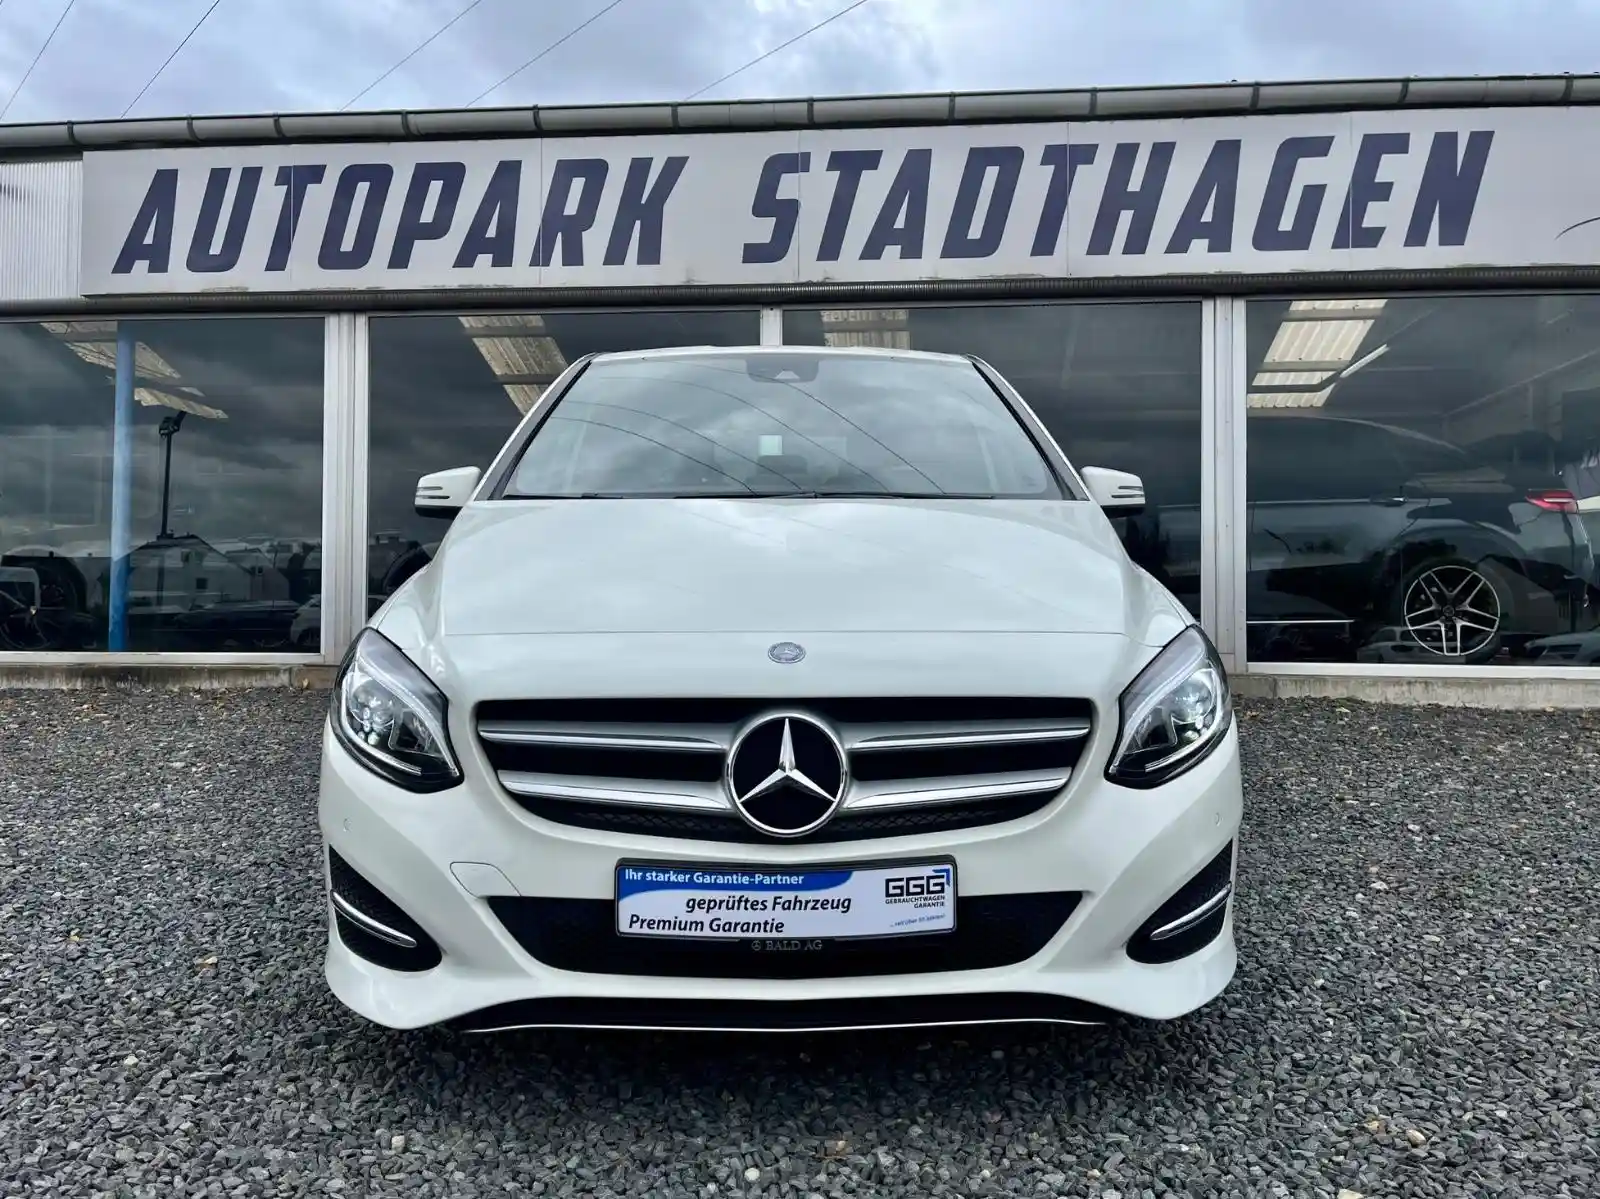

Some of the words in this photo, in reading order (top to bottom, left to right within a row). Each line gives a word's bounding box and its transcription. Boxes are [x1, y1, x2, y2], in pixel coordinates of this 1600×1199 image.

[111, 156, 689, 274] AUTOPARK
[742, 130, 1495, 264] STADTHAGEN
[625, 869, 642, 881] Ihr
[646, 869, 690, 883] starker
[693, 872, 804, 885] Garantie-Partner
[885, 875, 944, 898] GGG
[686, 895, 768, 913] geprüftes
[771, 896, 852, 913] Fahrzeug
[885, 895, 945, 904] GEBRAUCHTWAGEN
[913, 901, 945, 909] GARANTIE
[629, 914, 704, 932] Premium
[709, 918, 785, 933] Garantie
[765, 941, 801, 951] BALD
[804, 940, 823, 950] AG
